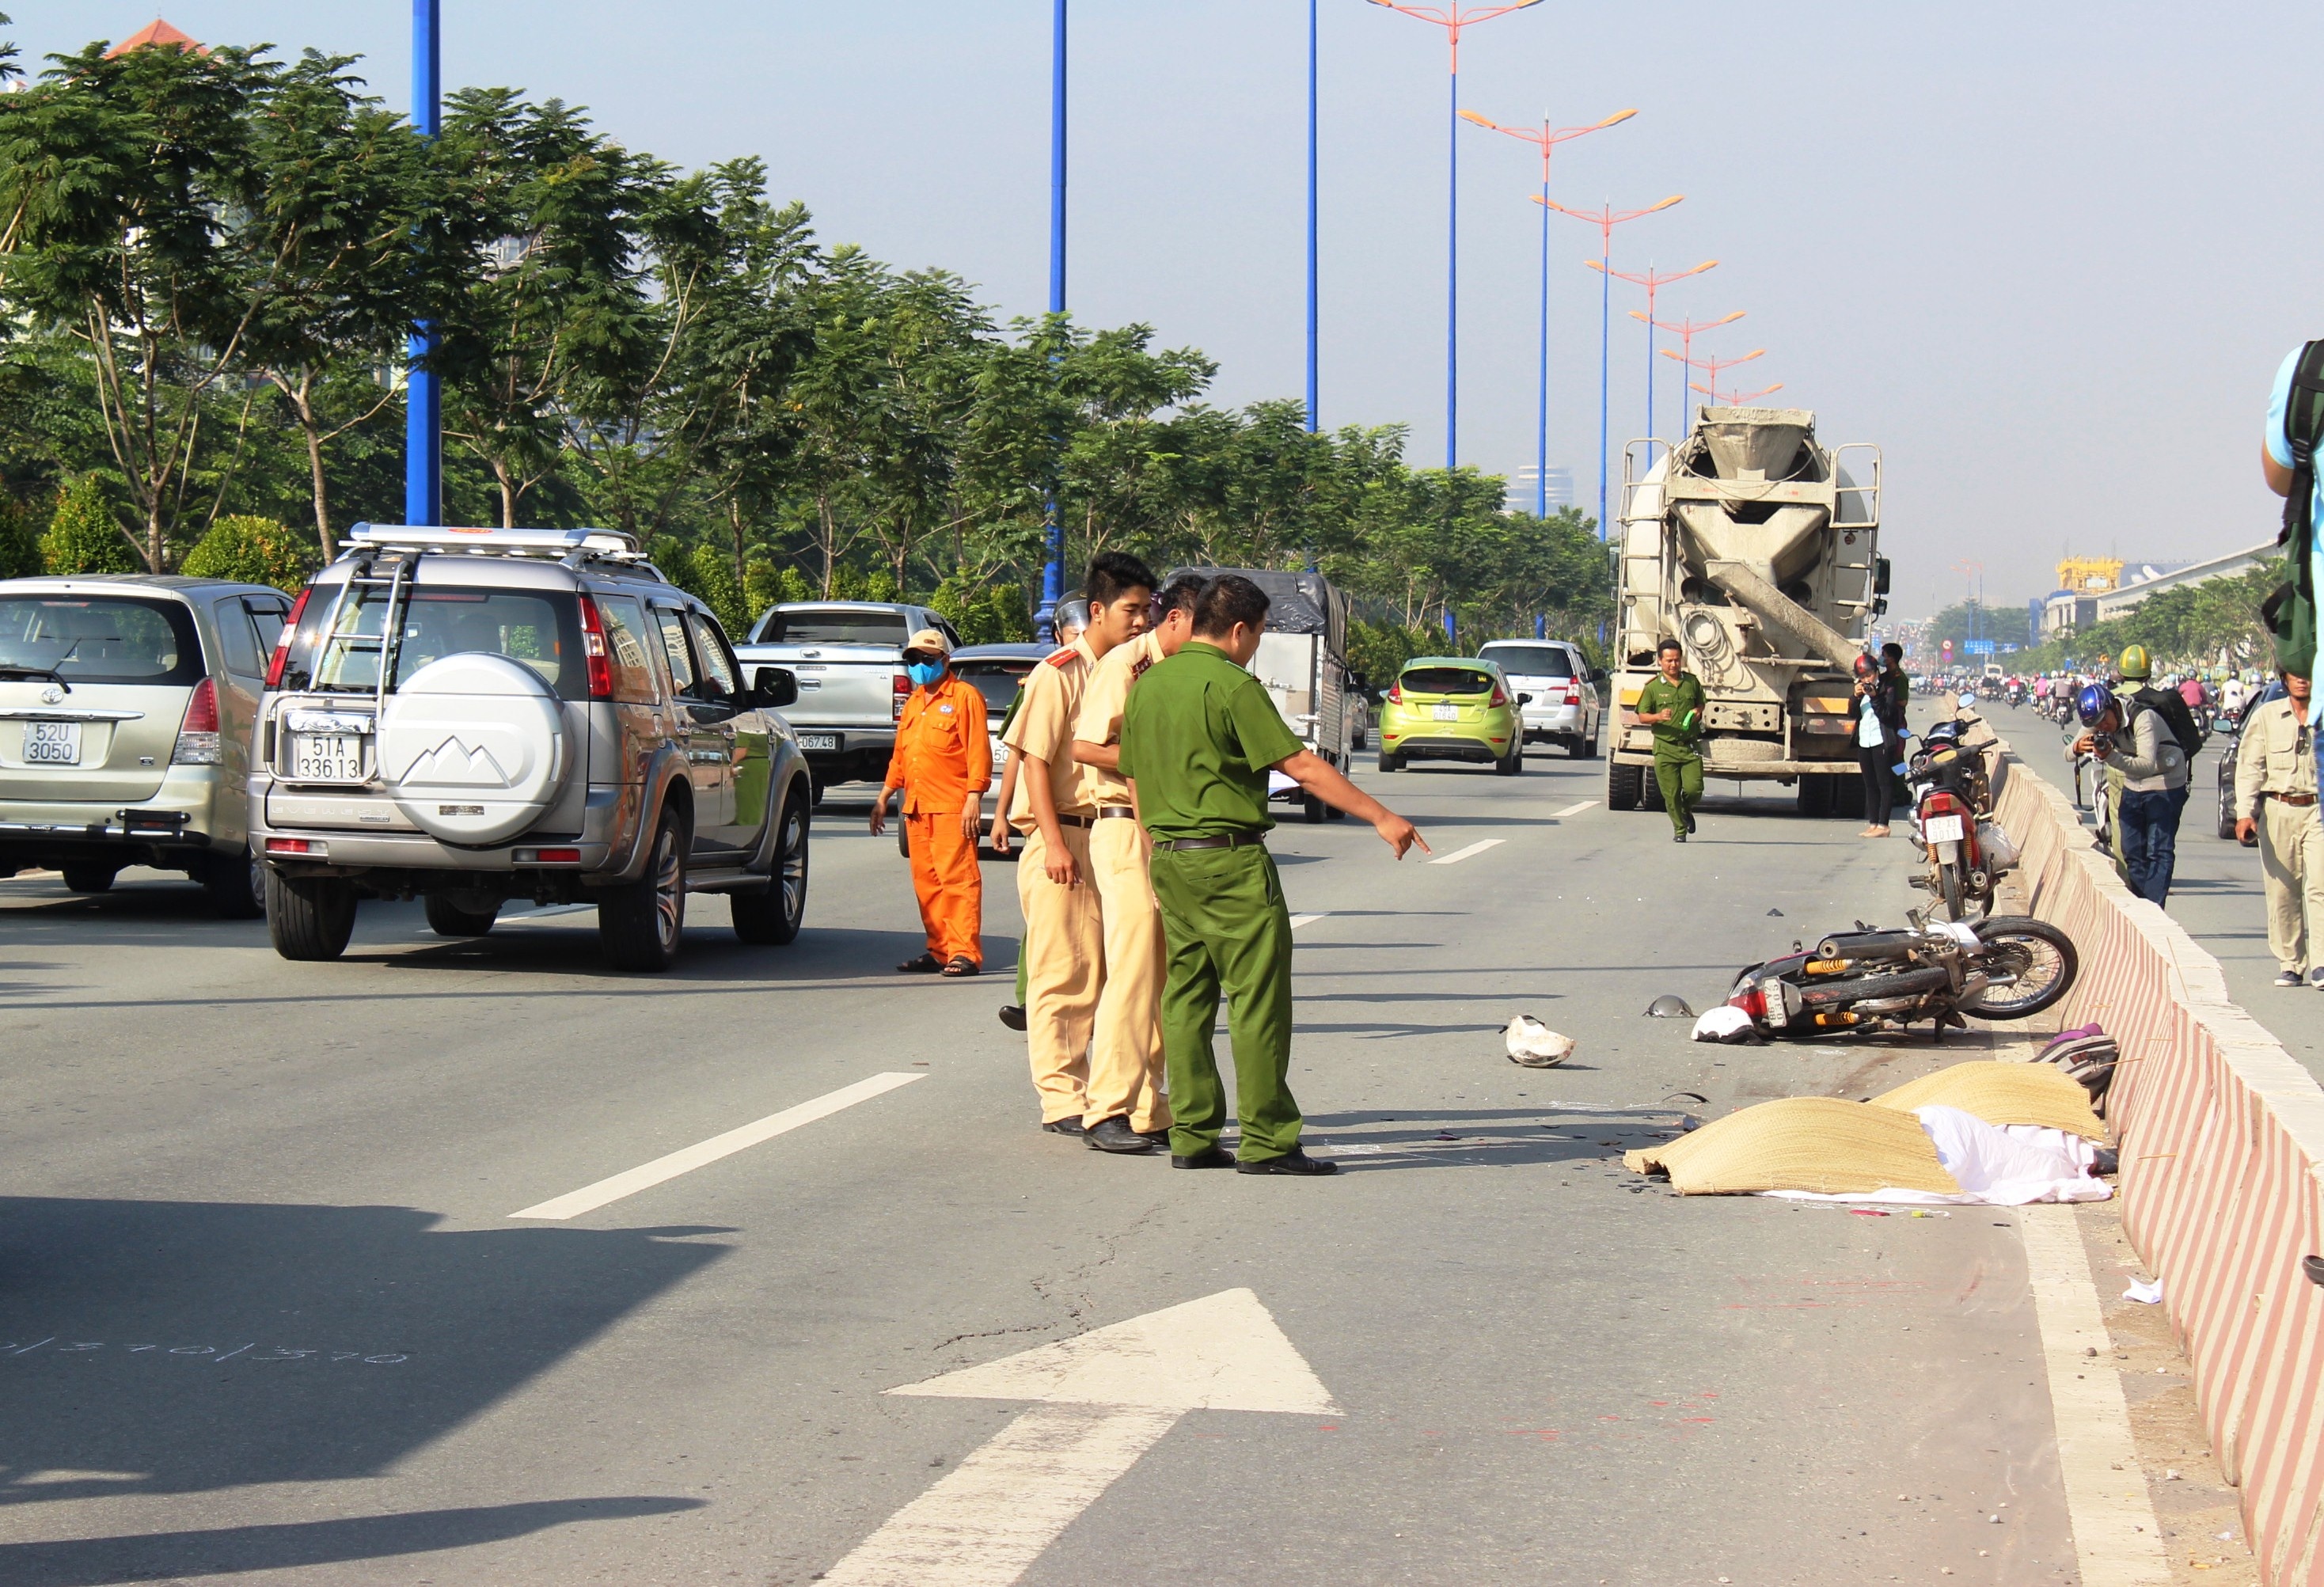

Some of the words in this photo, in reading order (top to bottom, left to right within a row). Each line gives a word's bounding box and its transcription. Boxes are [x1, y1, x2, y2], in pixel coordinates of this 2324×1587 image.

[36, 724, 69, 741] 52U
[29, 742, 73, 760] 3050
[313, 736, 344, 757] 51A
[301, 758, 359, 779] 336.13
[272, 806, 390, 815] EVEREST
